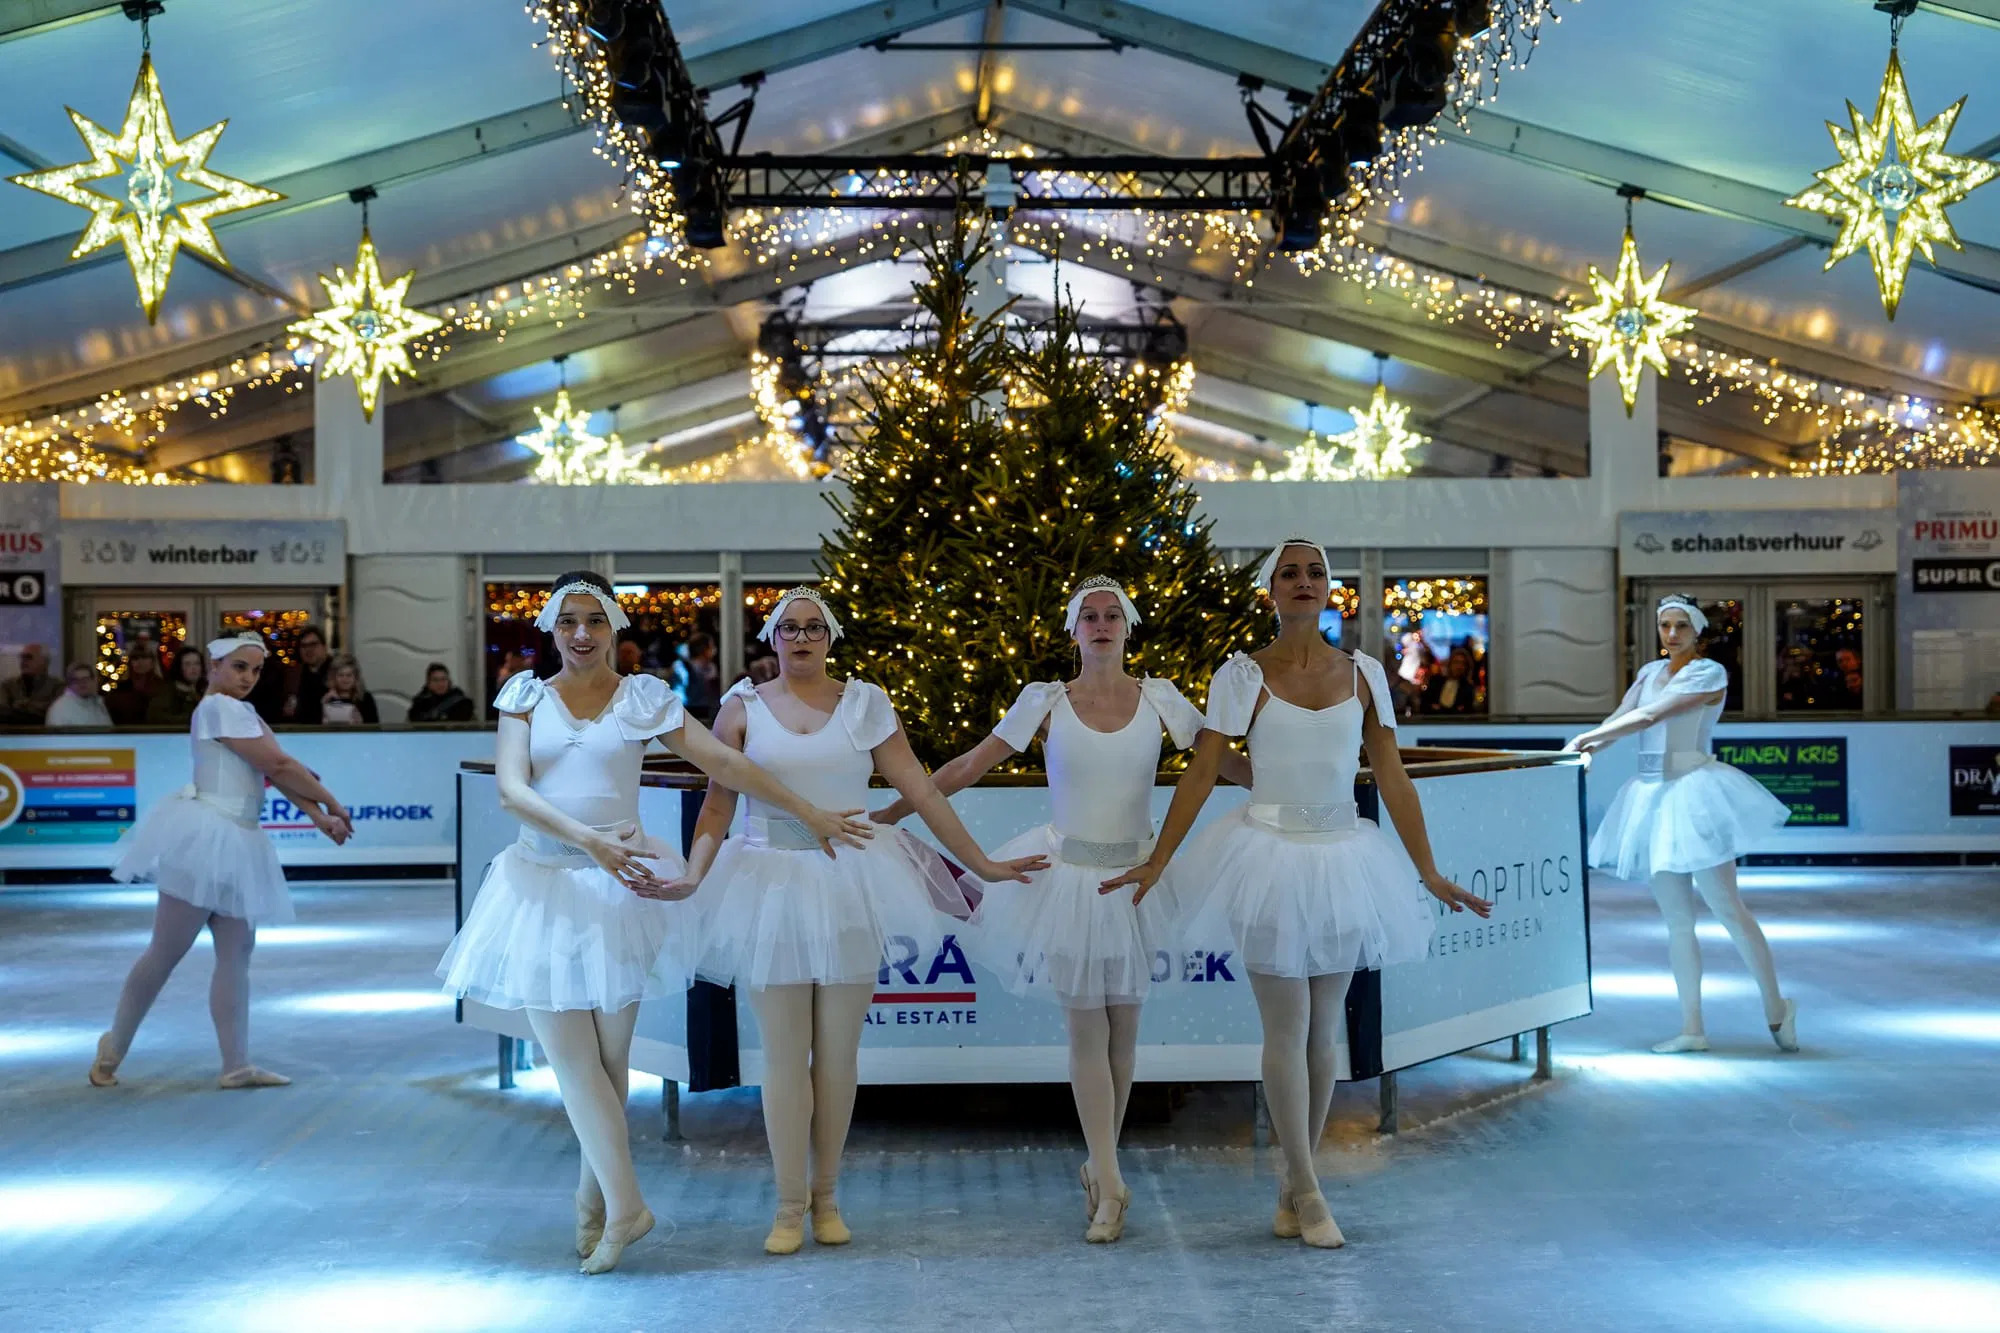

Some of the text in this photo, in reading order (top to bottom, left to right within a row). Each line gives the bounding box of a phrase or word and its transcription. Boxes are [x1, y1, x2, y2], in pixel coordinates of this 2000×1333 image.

[1671, 532, 1845, 553] schaatsverhuur
[149, 544, 259, 565] winterbar
[1917, 567, 1982, 584] SUPER
[1720, 745, 1840, 765] TUINEN KRIS
[1471, 855, 1571, 908] OPTICS
[896, 1010, 977, 1025] ESTATE
